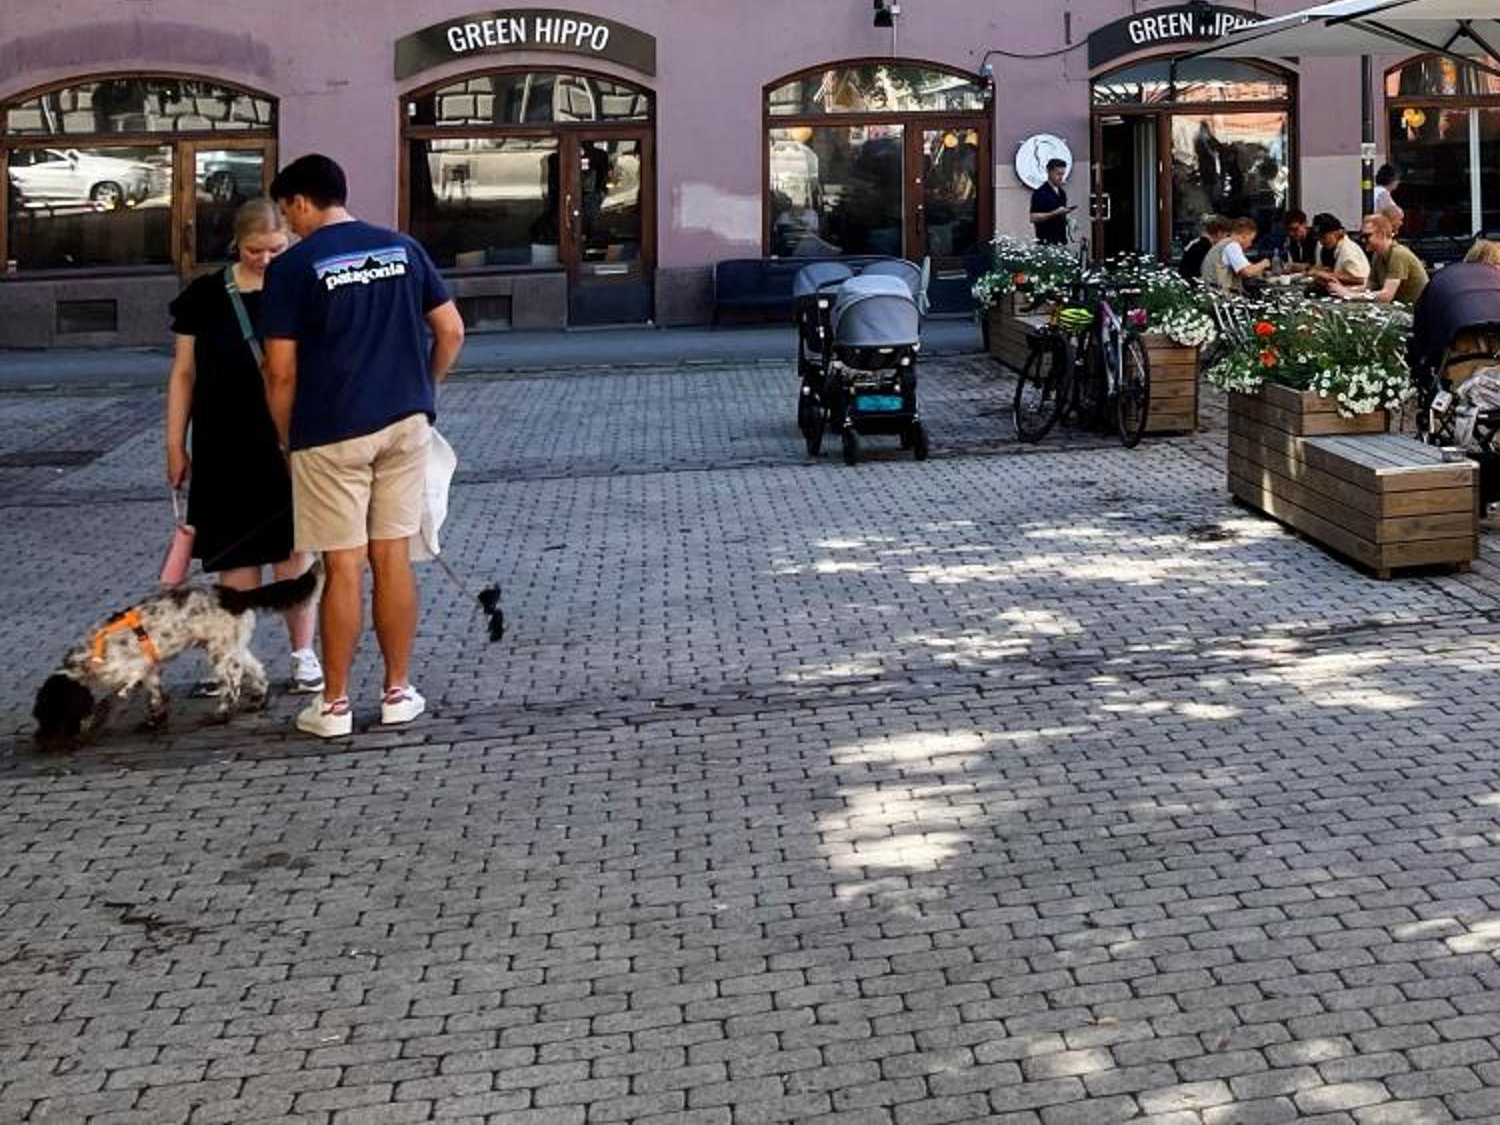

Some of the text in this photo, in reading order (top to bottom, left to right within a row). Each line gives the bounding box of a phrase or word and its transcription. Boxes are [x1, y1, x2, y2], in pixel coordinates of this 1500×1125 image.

[447, 17, 610, 52] GREEN HIPPO
[1129, 12, 1258, 44] GREEN IPP
[325, 262, 406, 291] patagonia
